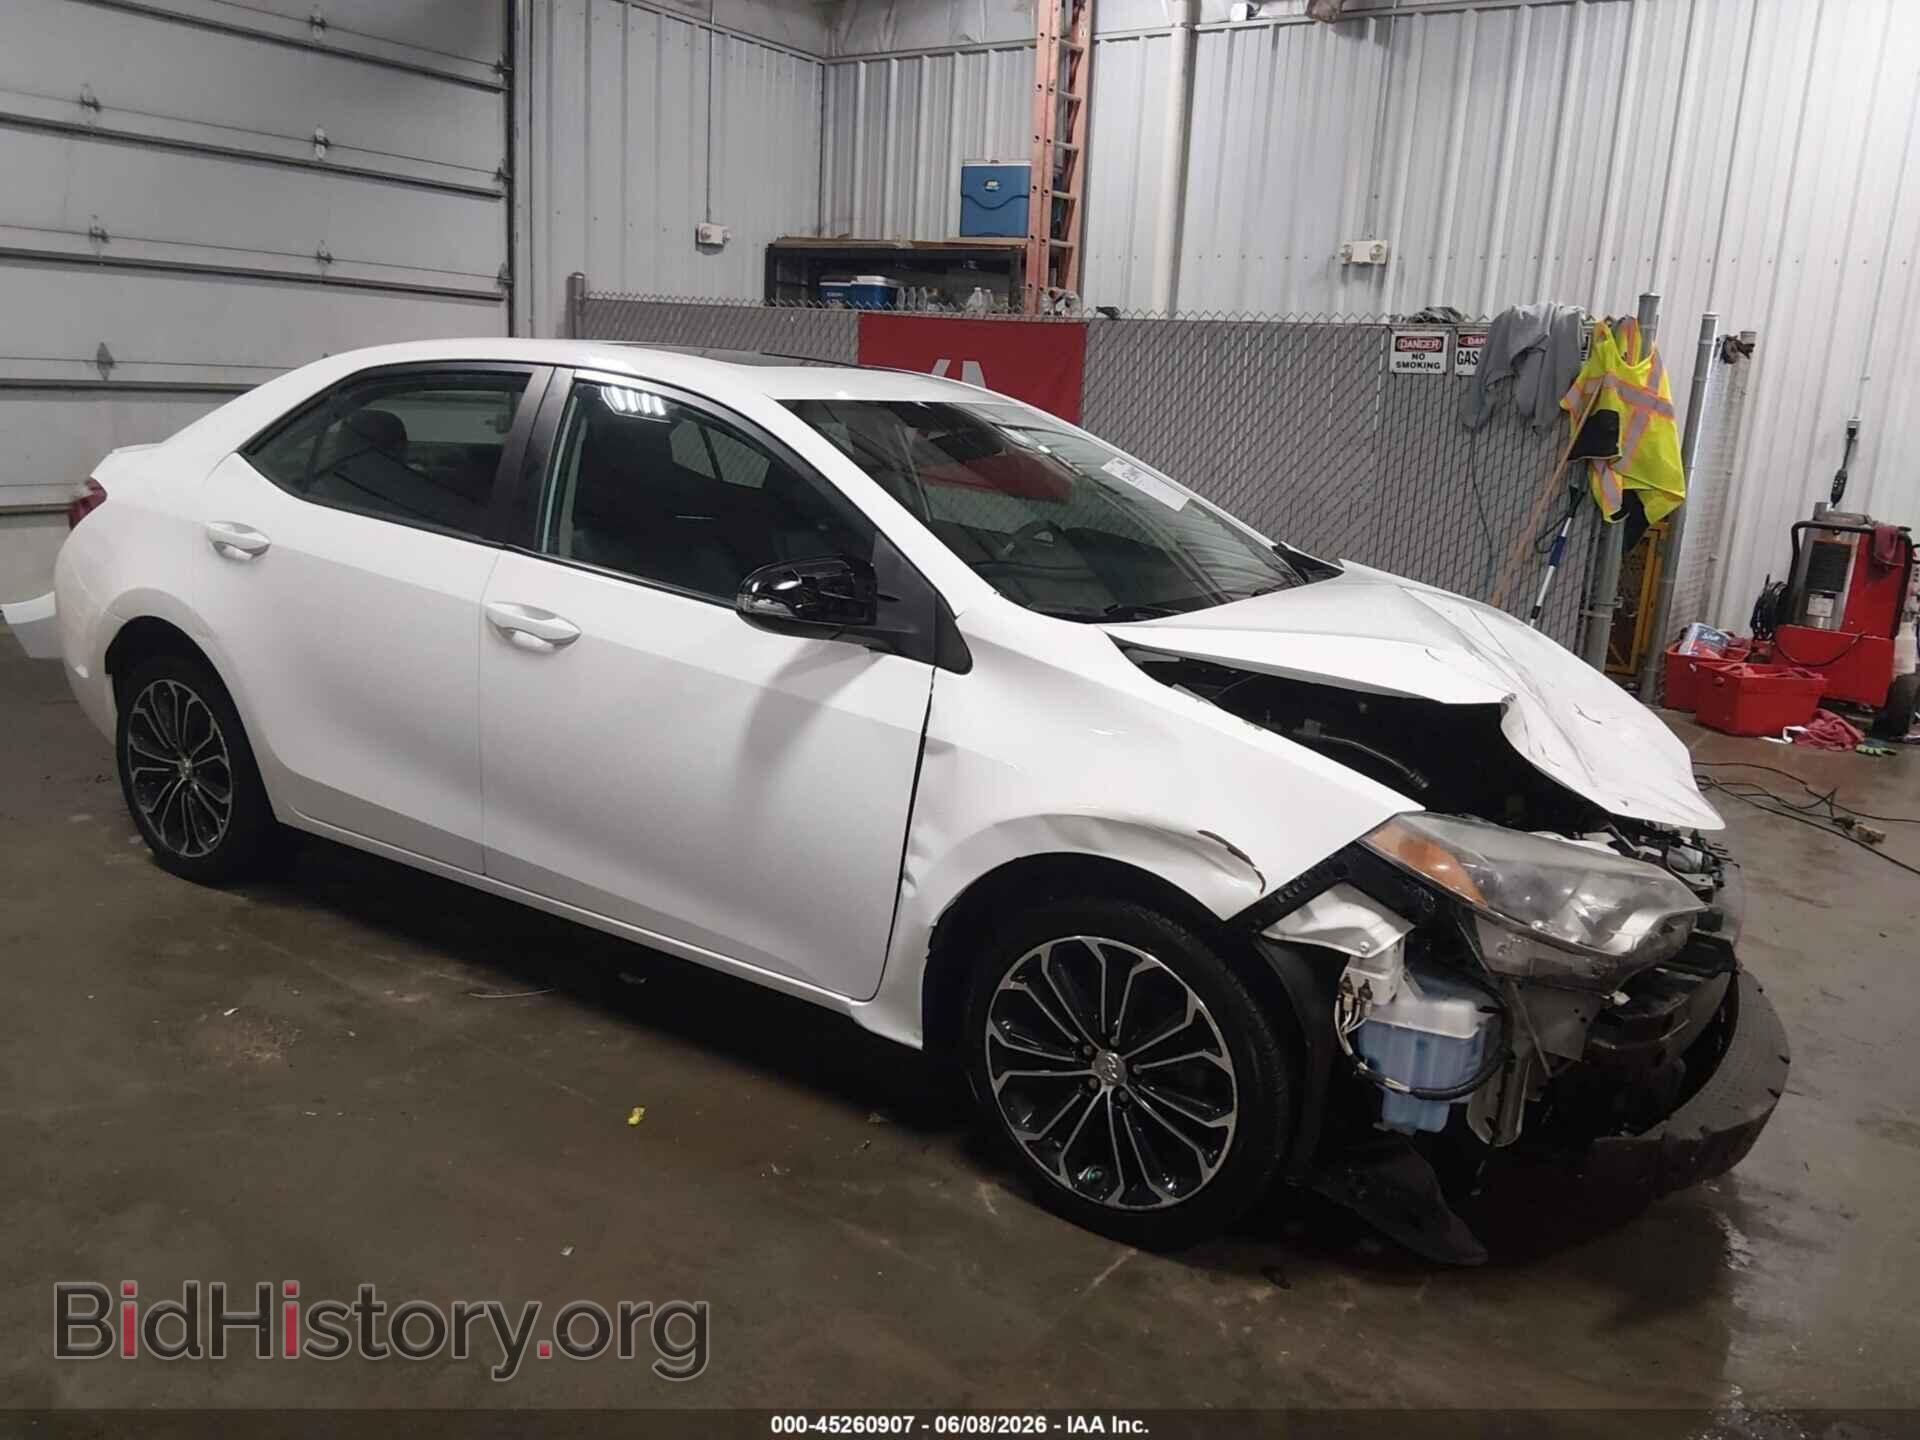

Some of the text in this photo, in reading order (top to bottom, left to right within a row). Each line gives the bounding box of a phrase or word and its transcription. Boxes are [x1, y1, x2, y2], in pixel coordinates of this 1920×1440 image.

[1399, 338, 1440, 350] DANGER
[1456, 351, 1479, 365] GAS
[1395, 361, 1441, 370] SMOKING
